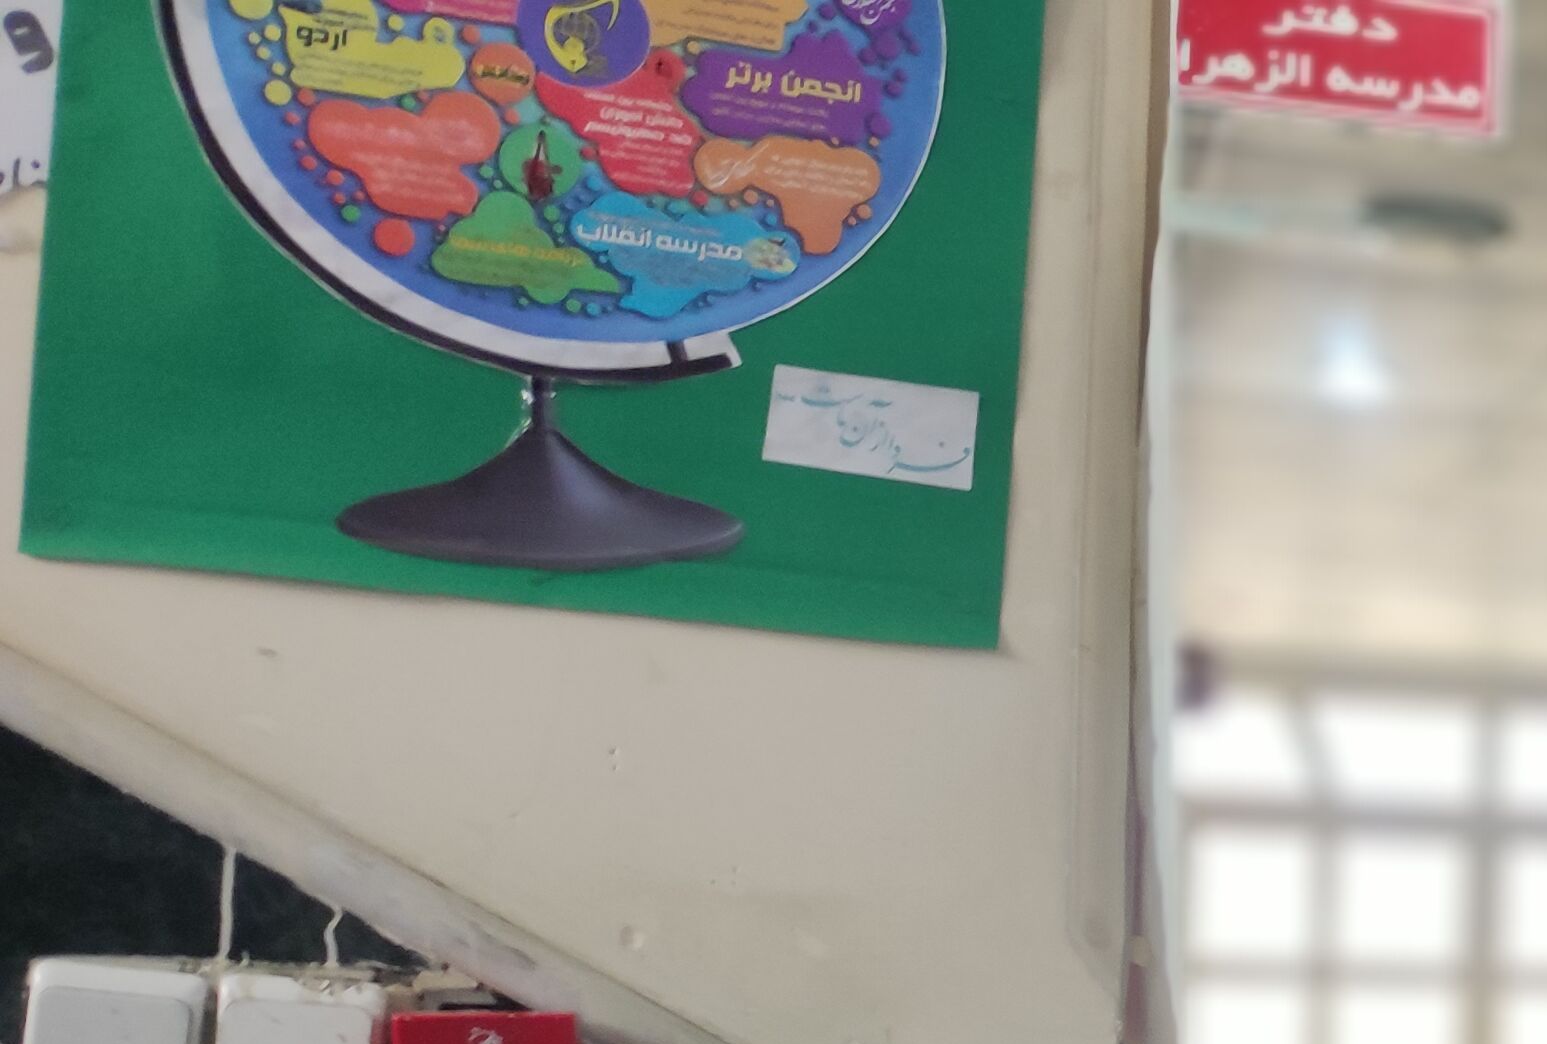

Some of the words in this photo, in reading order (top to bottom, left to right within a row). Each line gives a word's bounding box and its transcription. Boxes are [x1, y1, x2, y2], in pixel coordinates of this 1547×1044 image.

[296, 25, 348, 51] اردو
[1262, 5, 1398, 41] دفتر
[724, 60, 773, 93] برتر
[1178, 38, 1313, 93] الزهرا
[780, 69, 862, 105] انجمن
[1325, 65, 1481, 112] مدرسه
[576, 222, 653, 250] انقلاب
[655, 234, 744, 262] مدرسه
